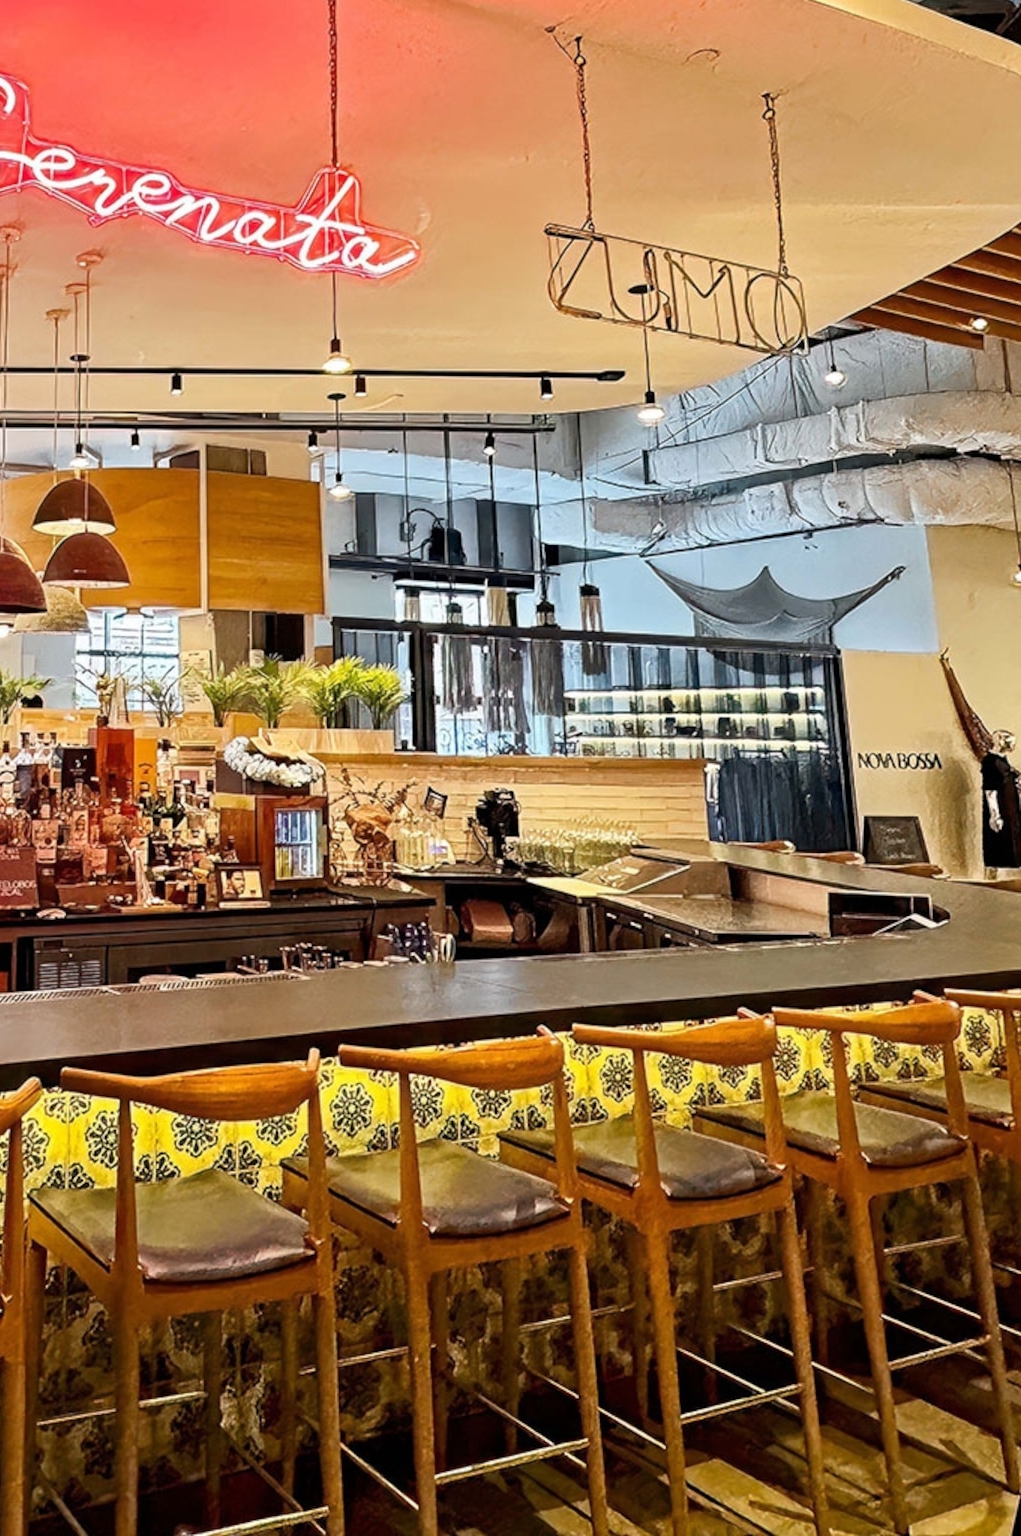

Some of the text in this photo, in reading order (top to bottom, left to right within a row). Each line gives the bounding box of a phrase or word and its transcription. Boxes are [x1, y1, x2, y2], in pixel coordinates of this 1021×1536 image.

[544, 222, 808, 356] ZUMO
[857, 752, 943, 770] NOVA BOSSA
